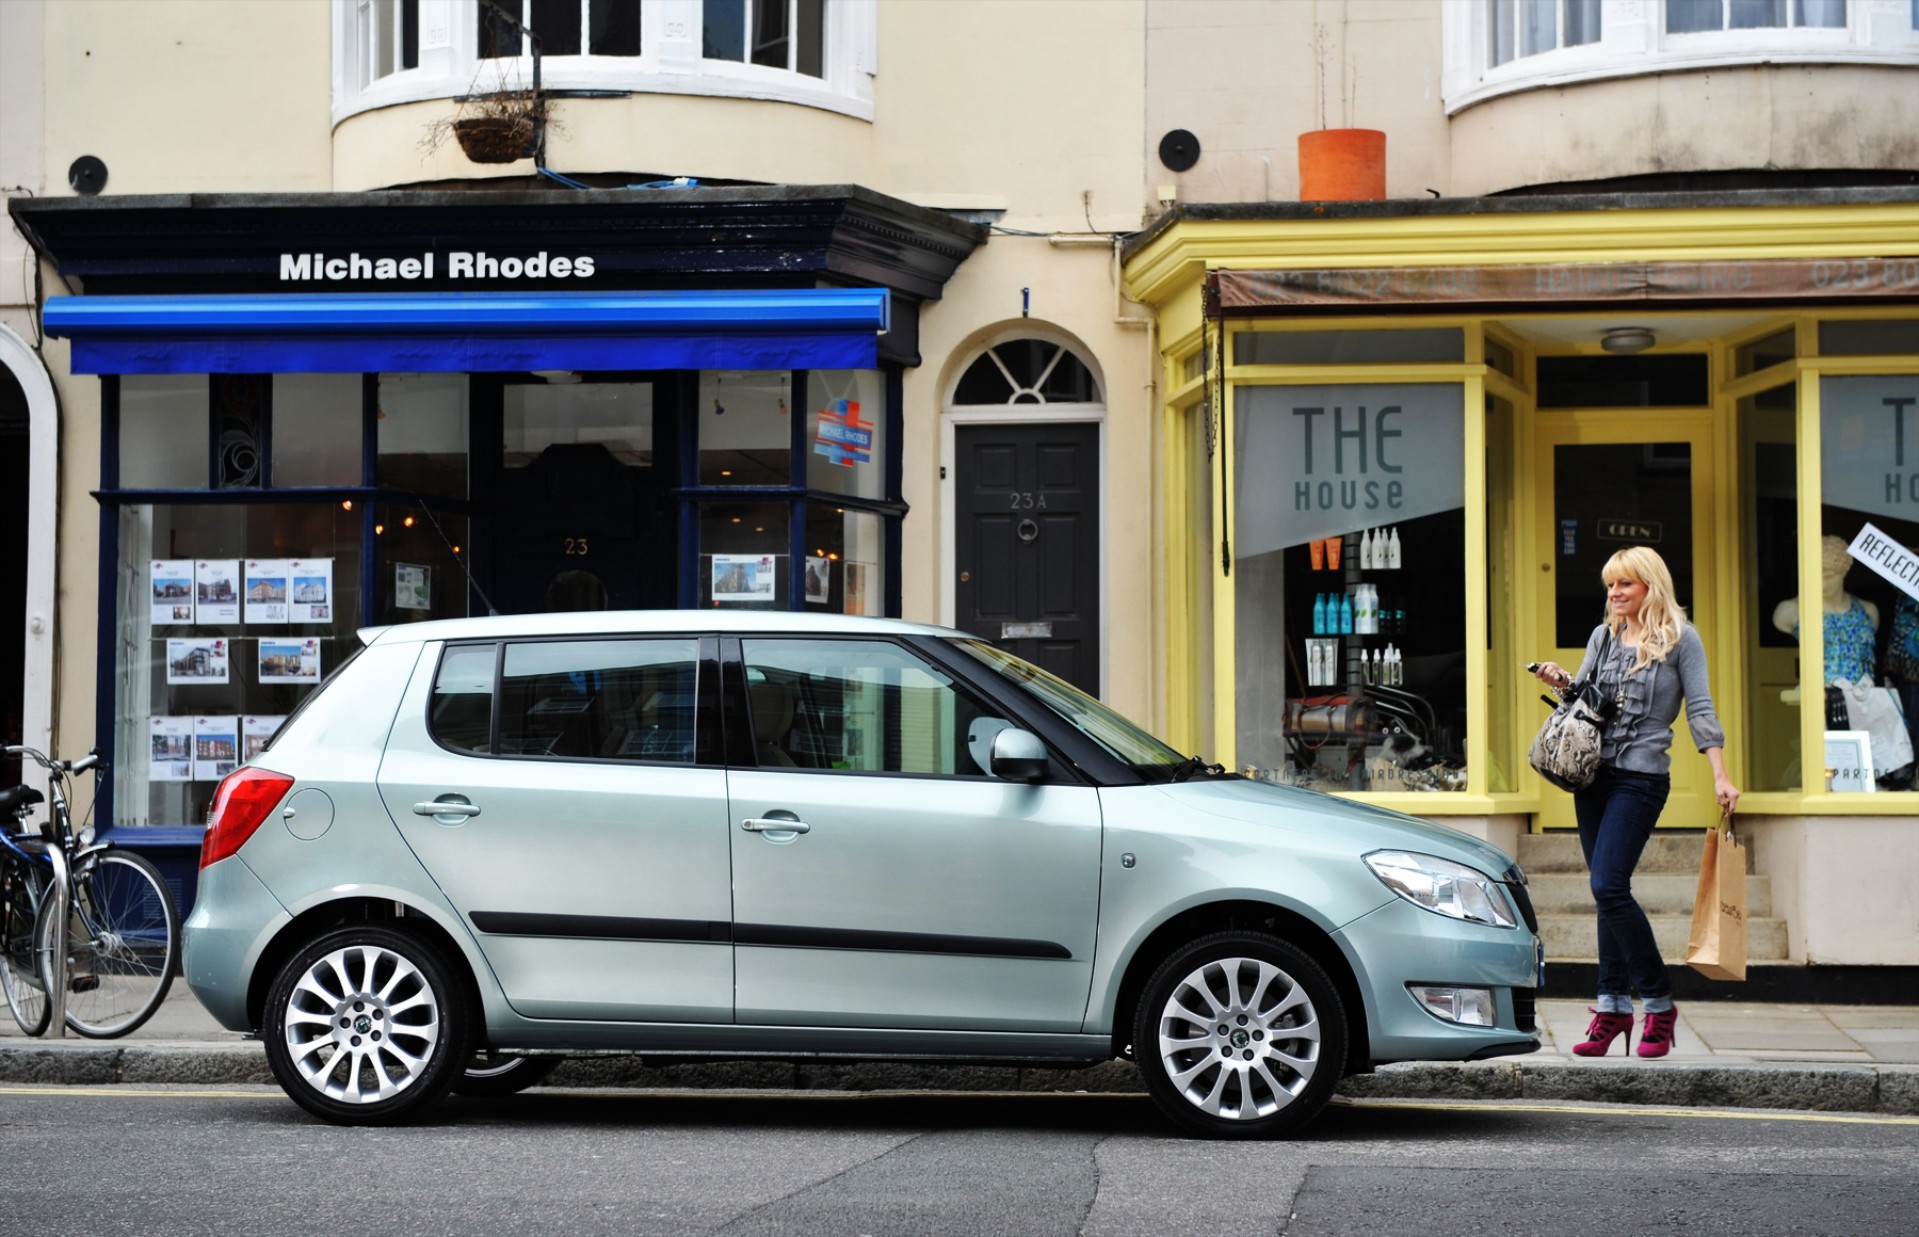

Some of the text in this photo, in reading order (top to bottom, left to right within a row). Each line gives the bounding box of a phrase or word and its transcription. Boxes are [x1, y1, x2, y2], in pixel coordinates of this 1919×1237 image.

[280, 251, 596, 280] Michael Rhodes
[1811, 260, 1869, 289] 023
[1292, 405, 1403, 475] THE
[1010, 492, 1047, 509] 23A
[564, 537, 588, 555] 23
